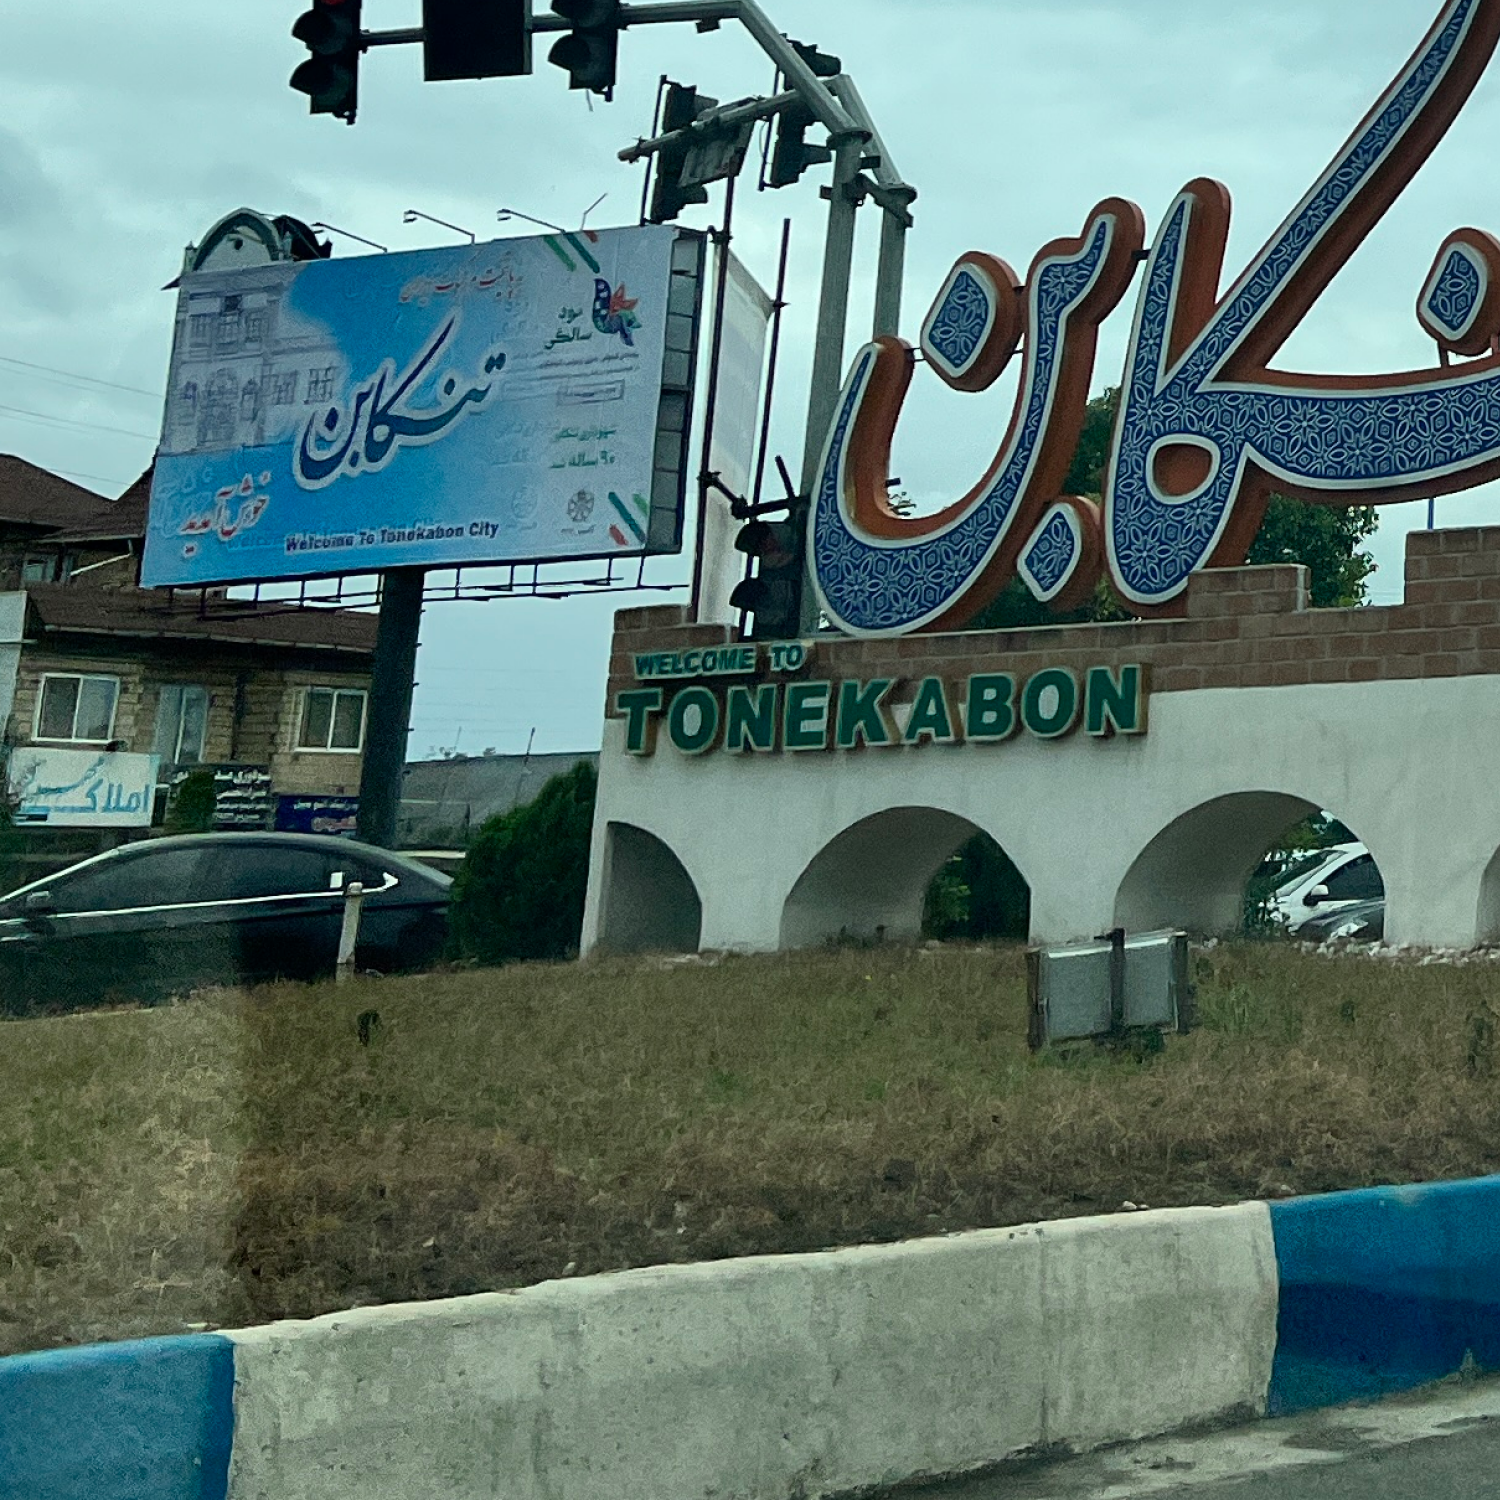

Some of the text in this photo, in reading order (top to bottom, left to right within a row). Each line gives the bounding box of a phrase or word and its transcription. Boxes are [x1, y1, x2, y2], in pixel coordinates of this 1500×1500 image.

[298, 314, 507, 484] تنکابن
[286, 533, 354, 552] Welcome
[358, 531, 375, 546] To
[468, 521, 500, 539] City
[634, 639, 808, 680] WELCOME TO
[616, 663, 1144, 756] TONEKABON
